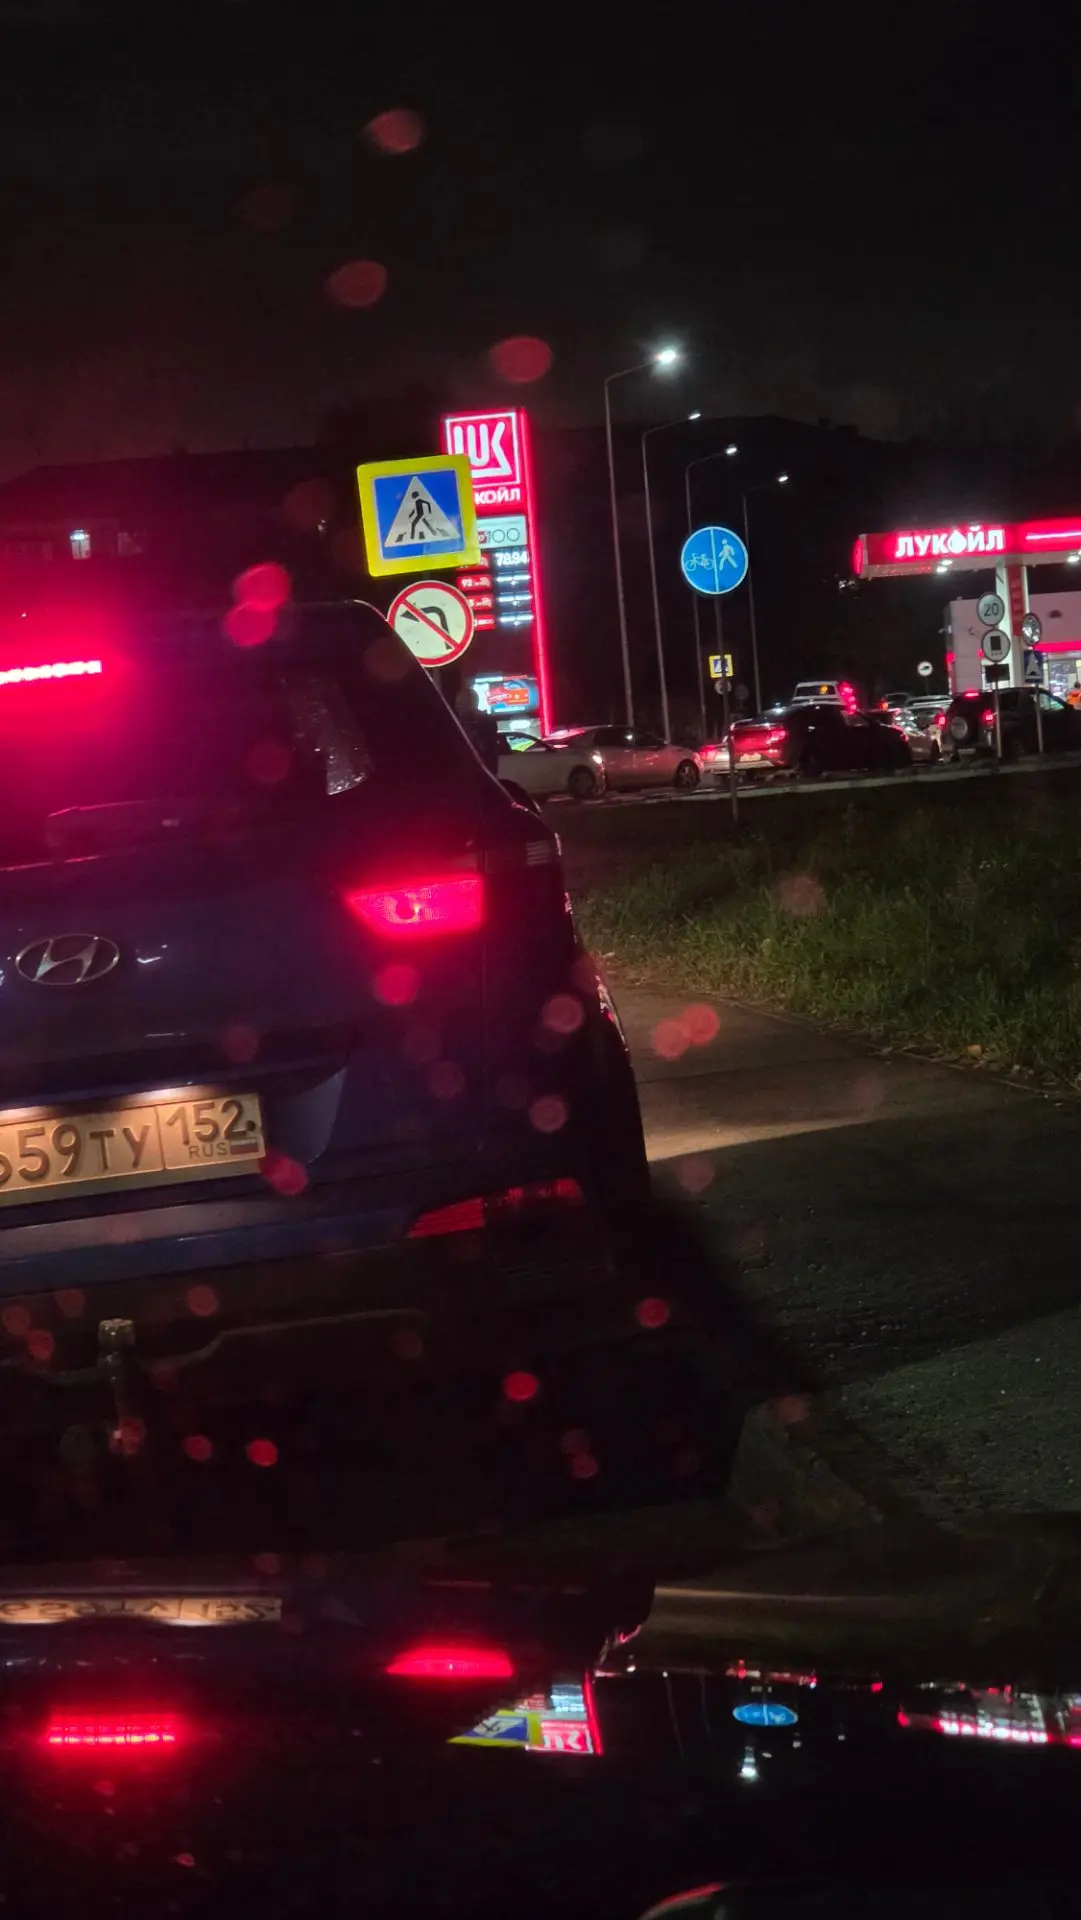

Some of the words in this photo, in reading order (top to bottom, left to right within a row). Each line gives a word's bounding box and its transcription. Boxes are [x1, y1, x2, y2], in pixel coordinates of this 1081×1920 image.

[474, 486, 521, 505] КОЙЛ
[895, 525, 1005, 558] ЛУКОЙЛ
[984, 602, 1000, 617] 20
[166, 1099, 247, 1146] 152
[189, 1141, 229, 1160] RUS
